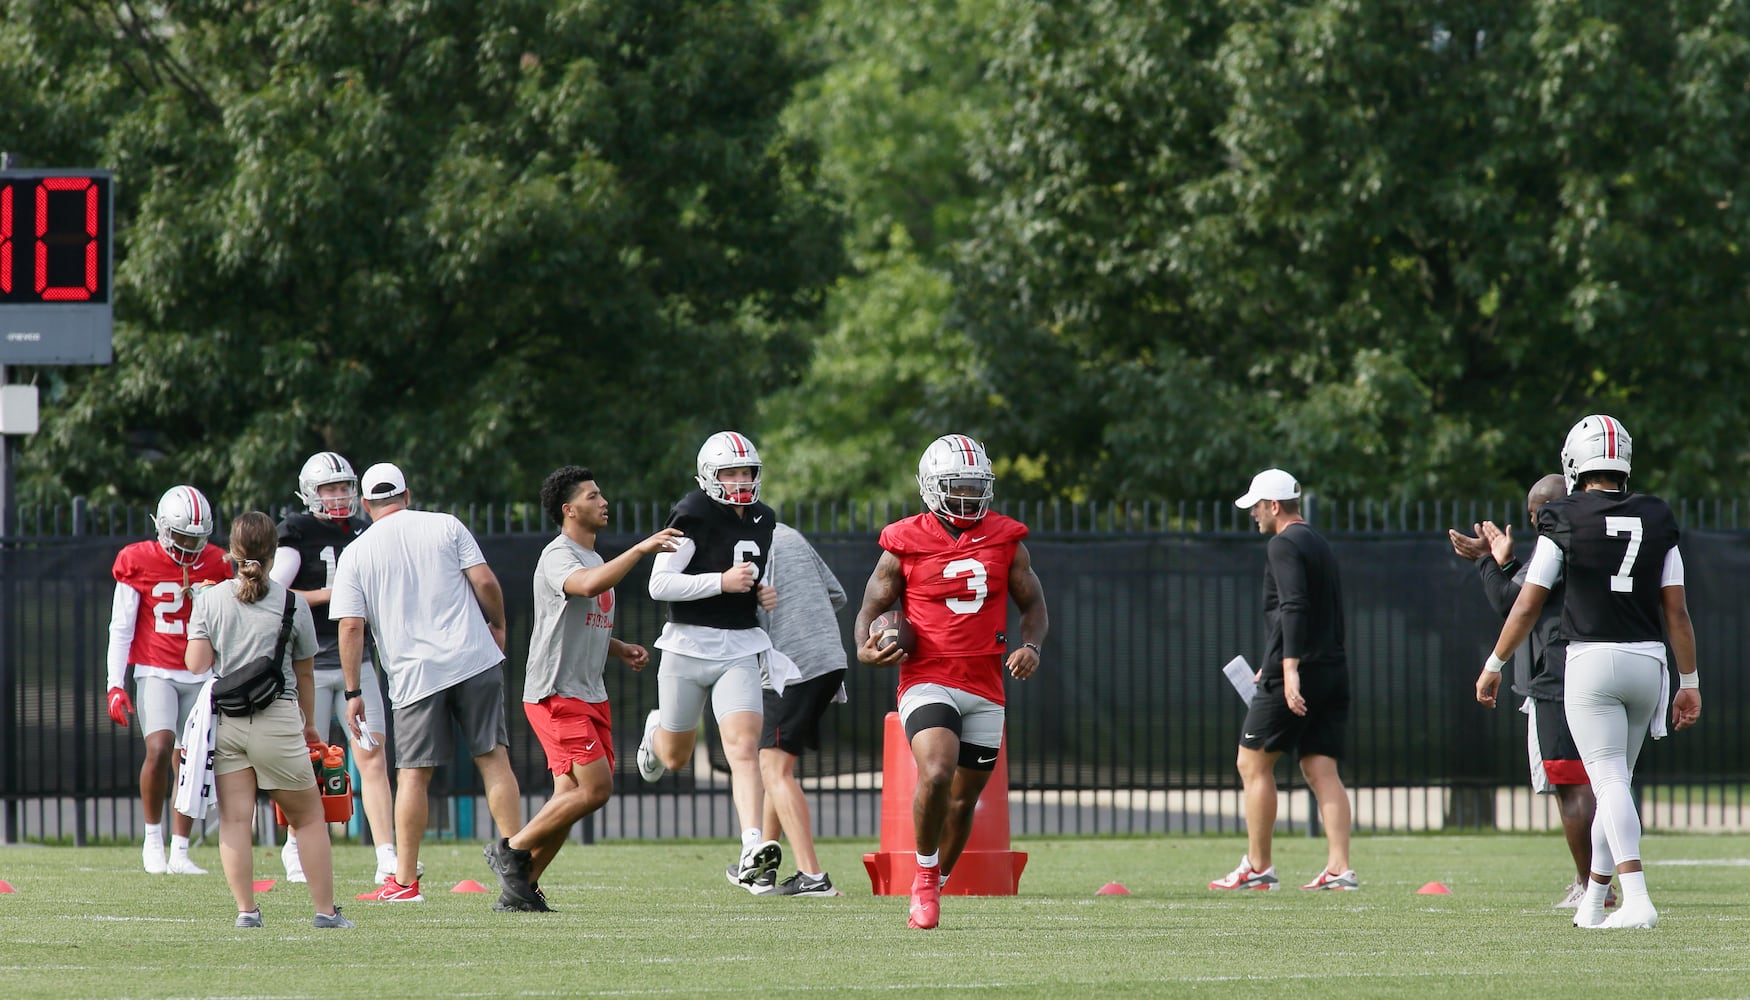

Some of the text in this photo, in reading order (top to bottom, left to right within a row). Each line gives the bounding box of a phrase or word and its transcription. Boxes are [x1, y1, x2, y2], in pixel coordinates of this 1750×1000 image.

[1605, 516, 1643, 592] 7
[152, 582, 201, 634] 2
[943, 558, 988, 614] 3
[328, 775, 342, 790] G
